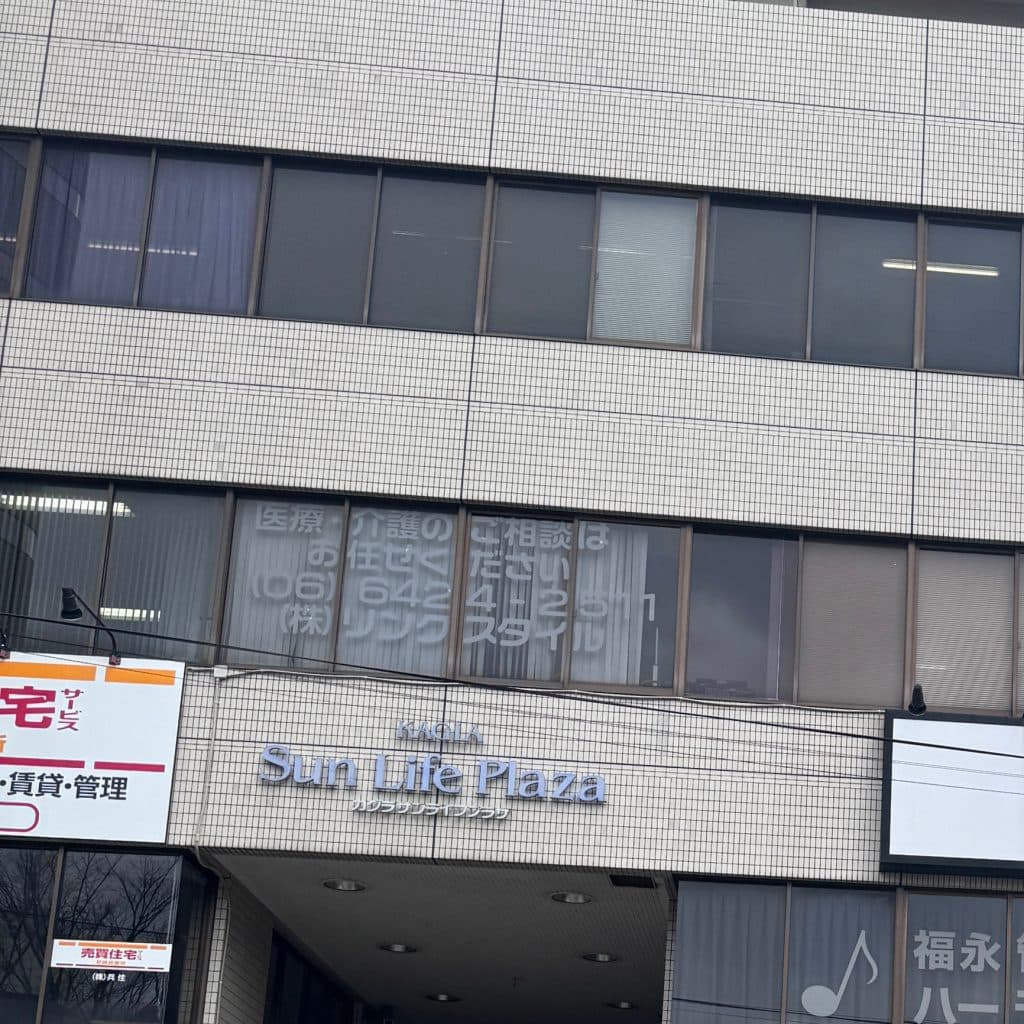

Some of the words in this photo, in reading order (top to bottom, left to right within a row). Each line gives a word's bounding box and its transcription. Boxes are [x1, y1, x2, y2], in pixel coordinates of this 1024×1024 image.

[57, 688, 84, 731] サービス
[260, 744, 357, 787] Sun
[373, 752, 463, 795] Life
[476, 758, 607, 804] Plaza
